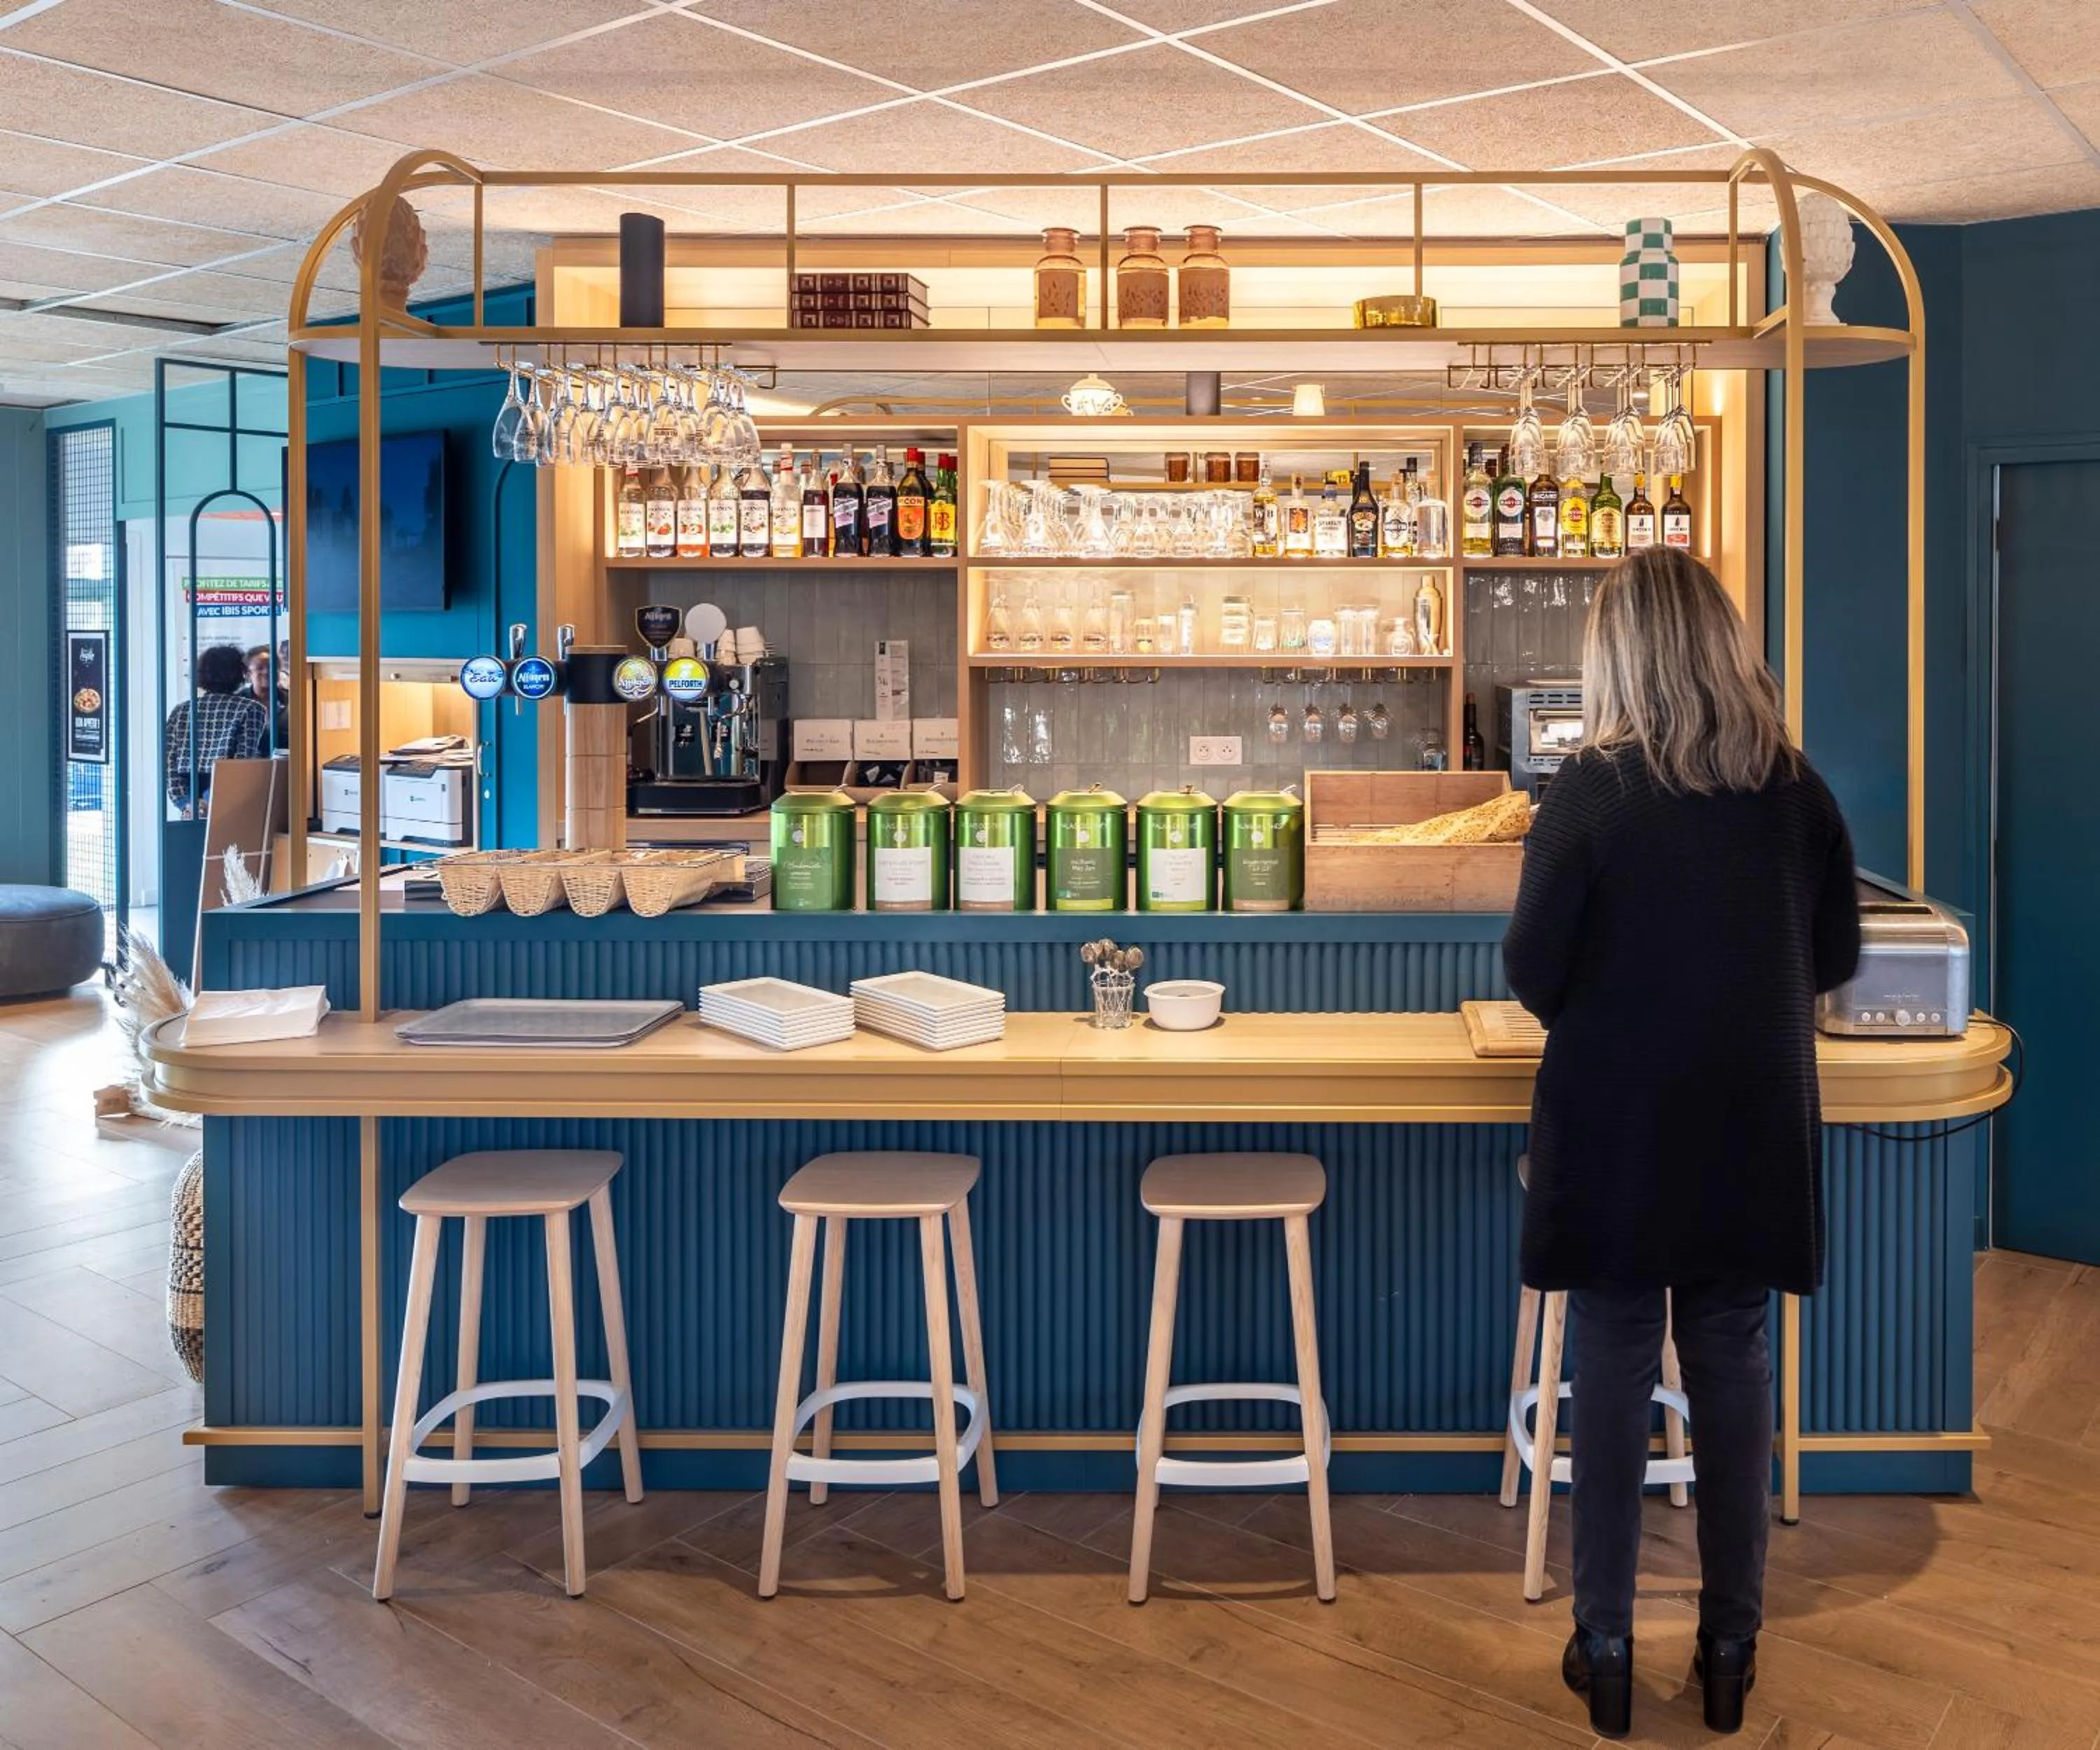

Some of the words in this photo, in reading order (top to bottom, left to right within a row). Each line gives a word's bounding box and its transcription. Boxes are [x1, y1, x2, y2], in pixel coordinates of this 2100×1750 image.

[183, 579, 224, 587] POFITEZ
[197, 607, 220, 617] AVEC
[222, 606, 240, 615] IBIS
[668, 680, 703, 688] PELFORTH
